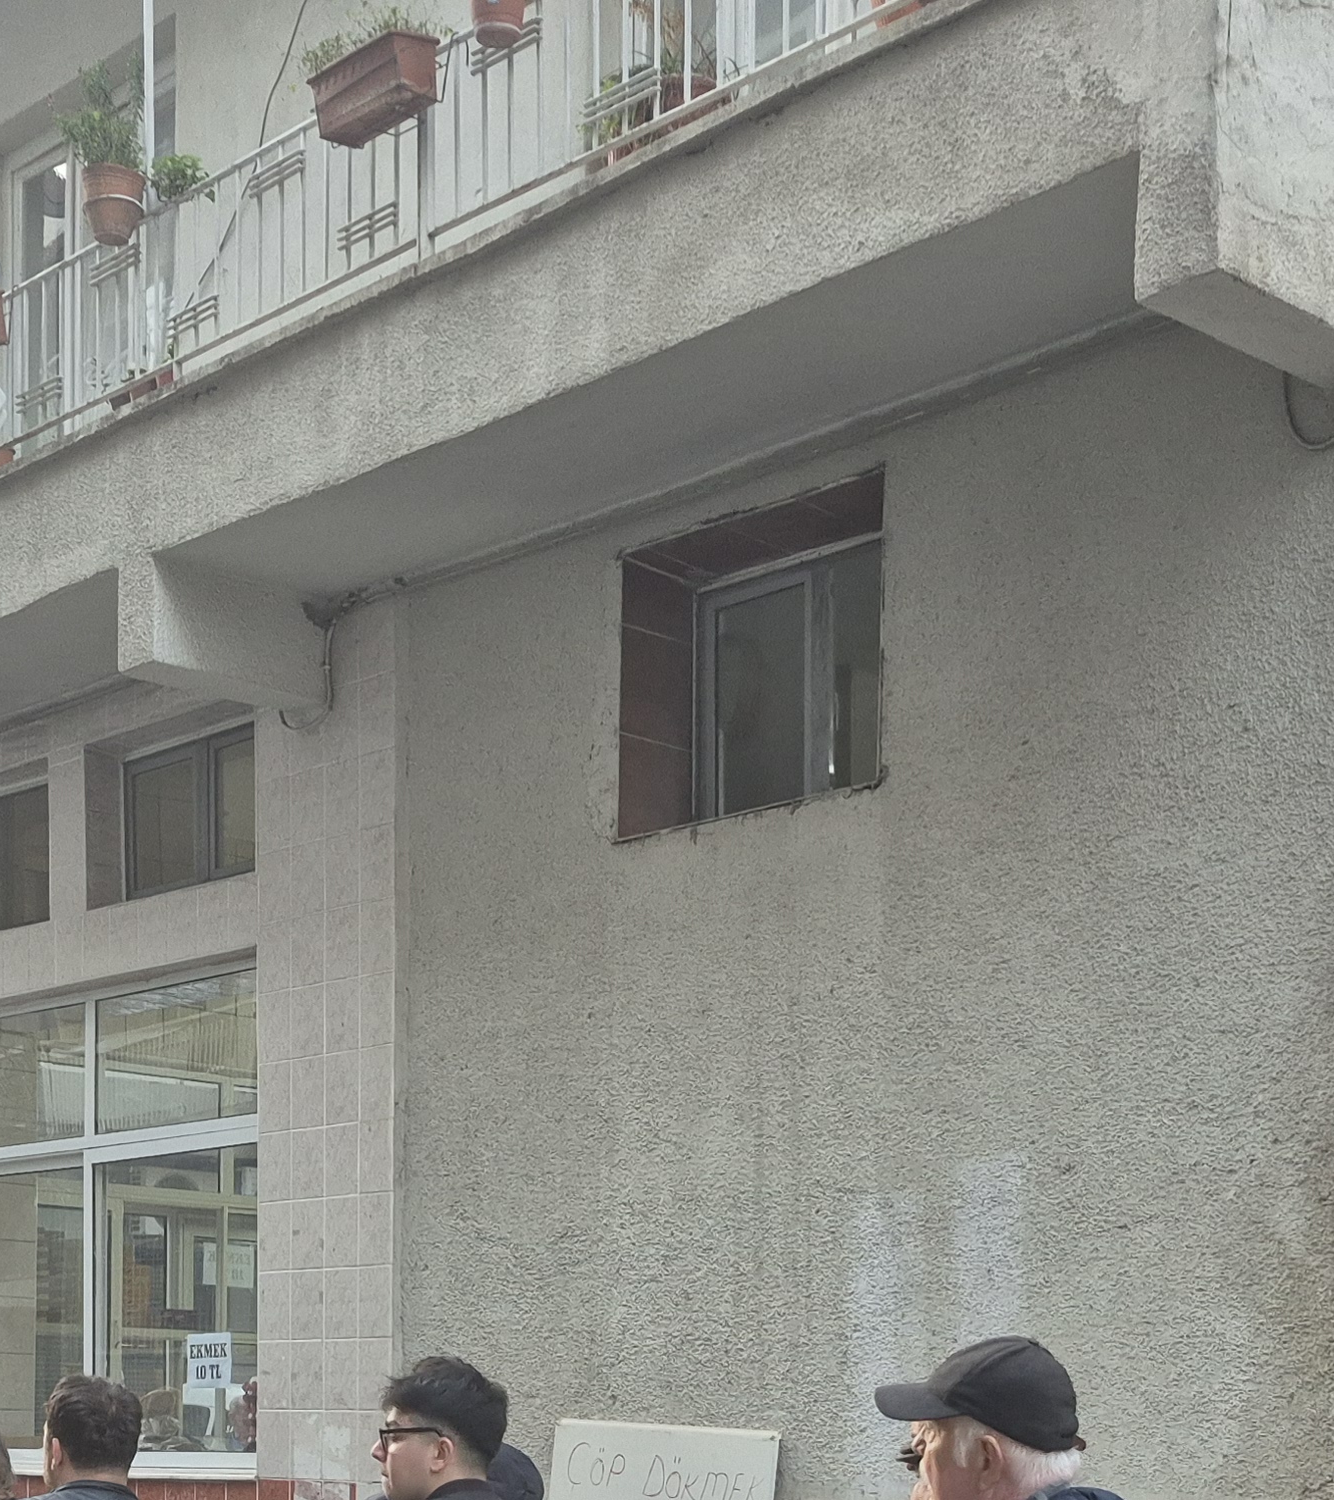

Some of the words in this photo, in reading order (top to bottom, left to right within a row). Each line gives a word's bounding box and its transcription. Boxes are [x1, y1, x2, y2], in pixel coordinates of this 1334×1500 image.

[189, 1342, 228, 1359] EKMEK
[195, 1365, 207, 1380] 10
[209, 1364, 222, 1380] TL
